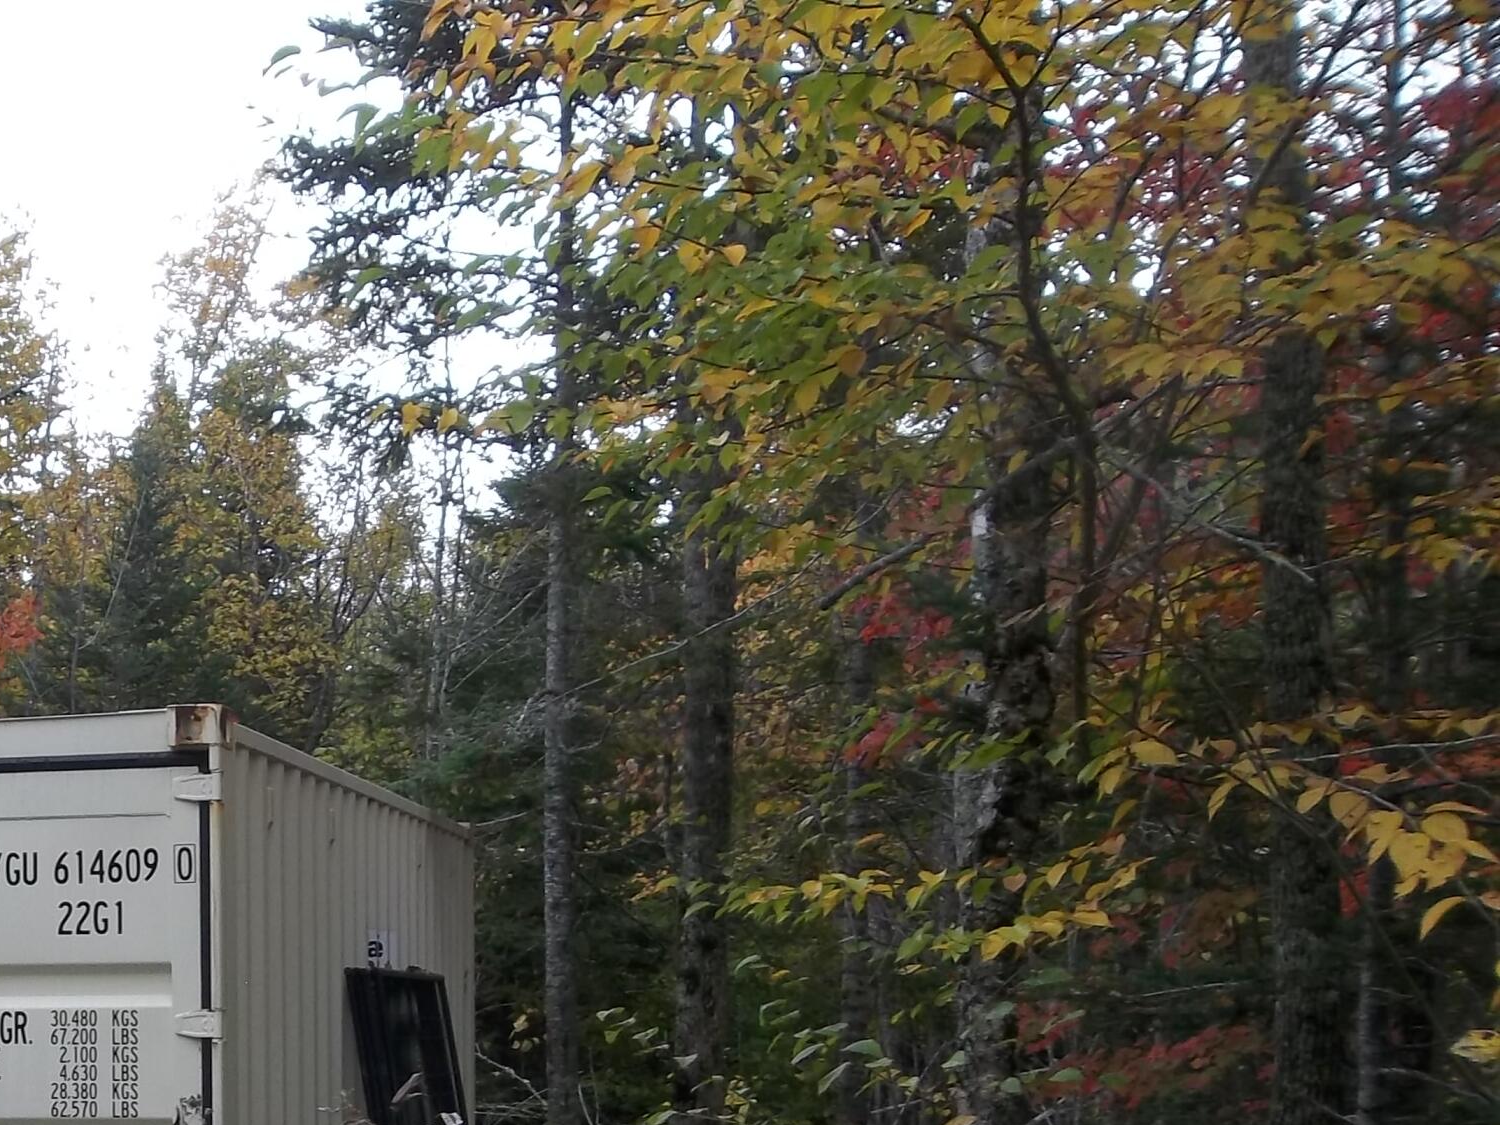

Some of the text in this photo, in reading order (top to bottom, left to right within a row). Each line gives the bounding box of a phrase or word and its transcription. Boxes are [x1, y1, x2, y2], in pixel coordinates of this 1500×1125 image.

[53, 847, 159, 885] 614609
[176, 846, 193, 881] 0
[57, 900, 123, 936] 22G1
[111, 1009, 139, 1028] KGS
[111, 1027, 139, 1046] LBS
[111, 1045, 139, 1064] KGS
[111, 1064, 139, 1082] LBS
[111, 1082, 139, 1100] KGS
[111, 1100, 139, 1118] LBS
